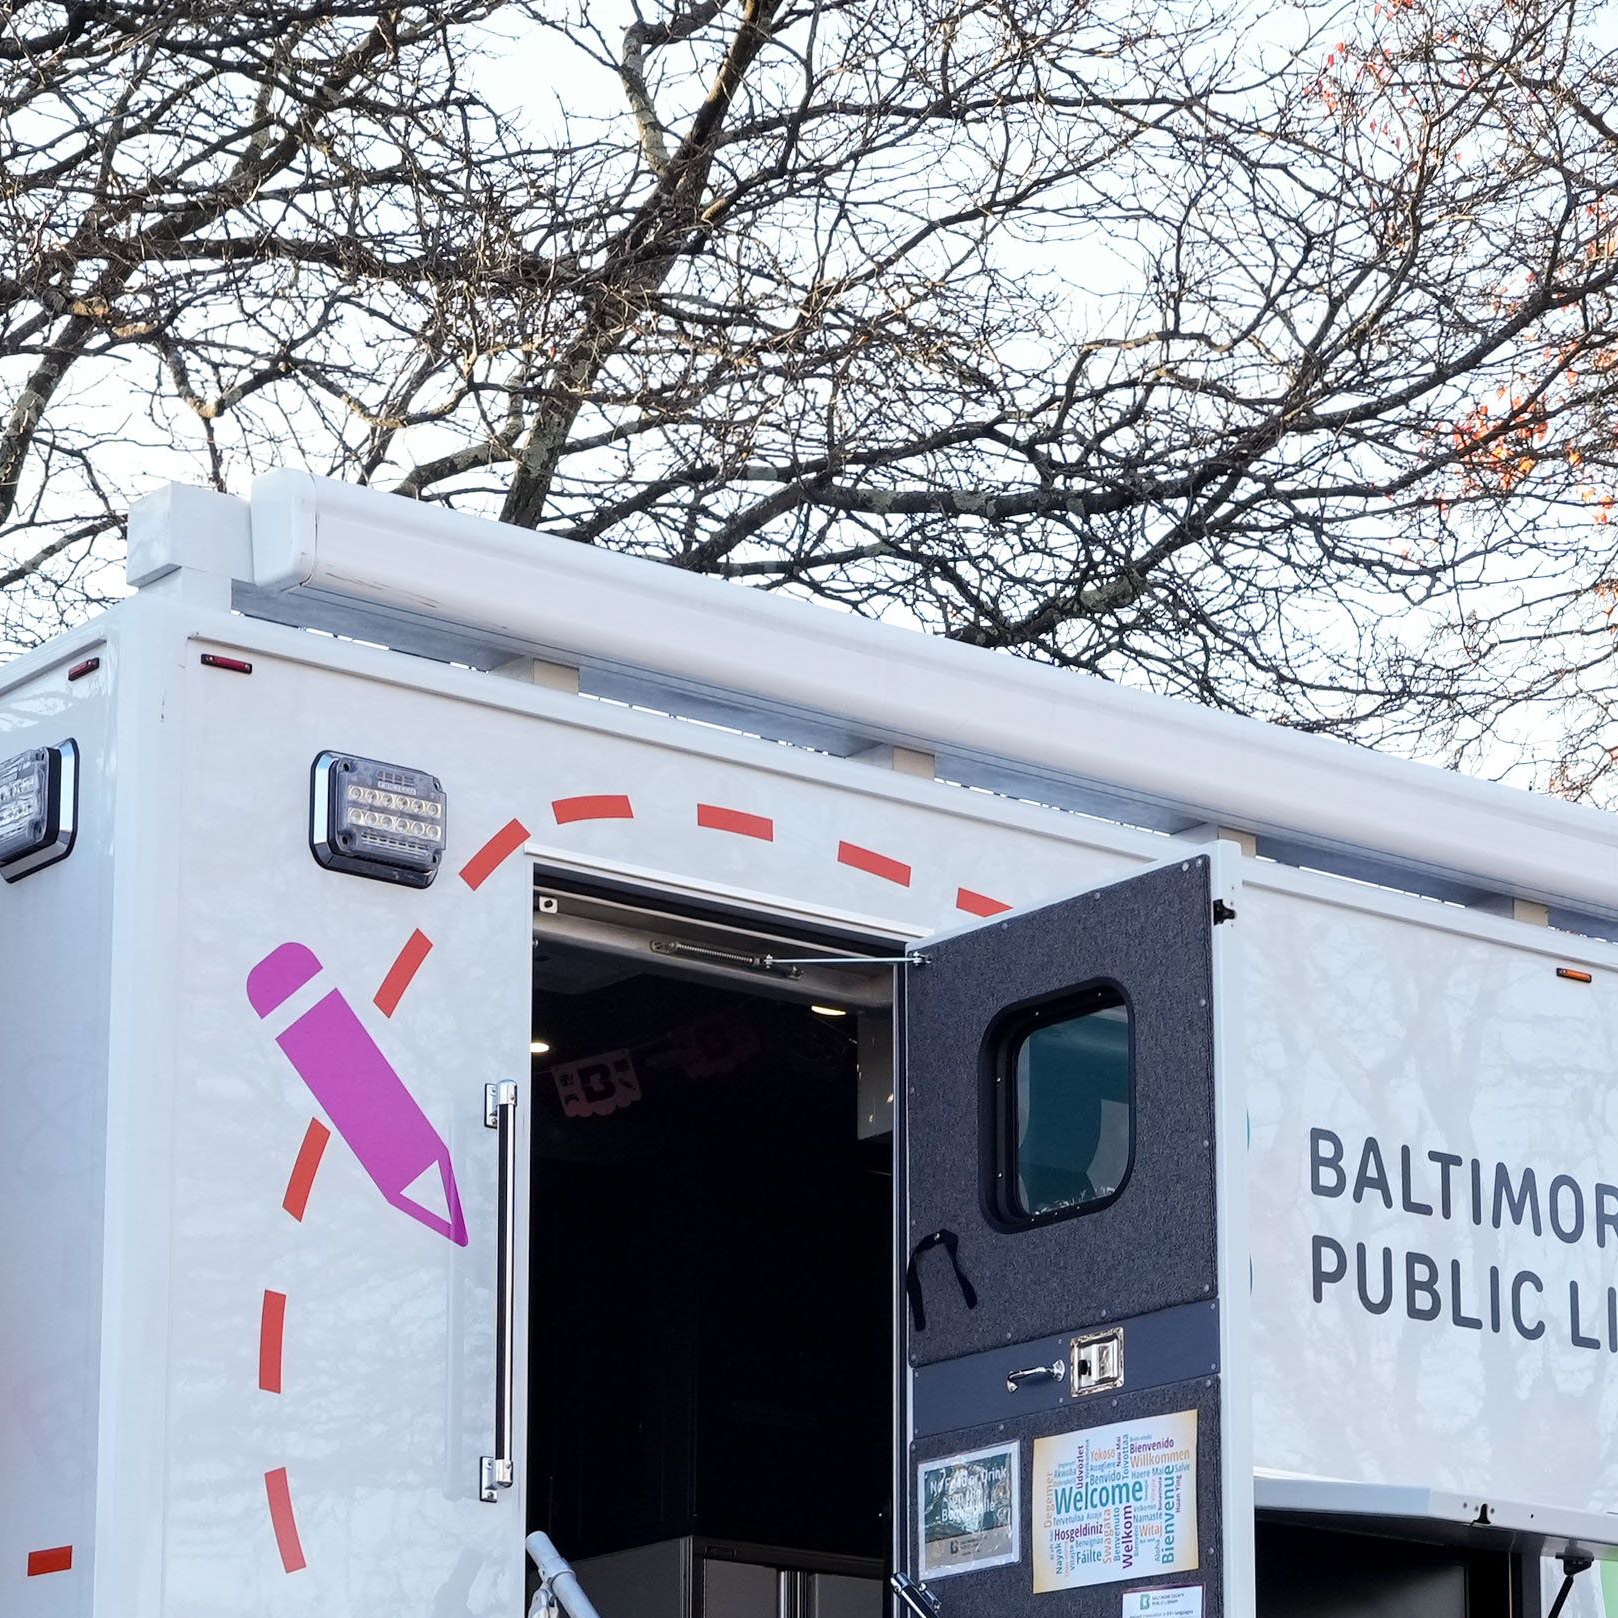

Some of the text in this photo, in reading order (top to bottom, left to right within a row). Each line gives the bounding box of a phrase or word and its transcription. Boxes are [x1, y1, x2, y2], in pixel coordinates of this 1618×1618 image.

[1311, 1234, 1547, 1341] PUBLIC
[1091, 1448, 1115, 1462] Yokoso
[1130, 1437, 1174, 1454] Bienvenido
[1130, 1449, 1190, 1468] Willkommen
[1175, 1463, 1190, 1473] Salve
[983, 1466, 1007, 1482] Drink
[1090, 1471, 1121, 1486] Benvido
[1044, 1472, 1055, 1528] Degemer
[1054, 1480, 1143, 1515] Welcome
[1134, 1512, 1162, 1523] Namaste
[1162, 1465, 1175, 1564] Bienvenue
[1055, 1522, 1103, 1542] Hosgeldiniz
[1103, 1509, 1113, 1564] Swagata
[1122, 1505, 1133, 1569] Welkom
[1140, 1524, 1163, 1538] Witaj
